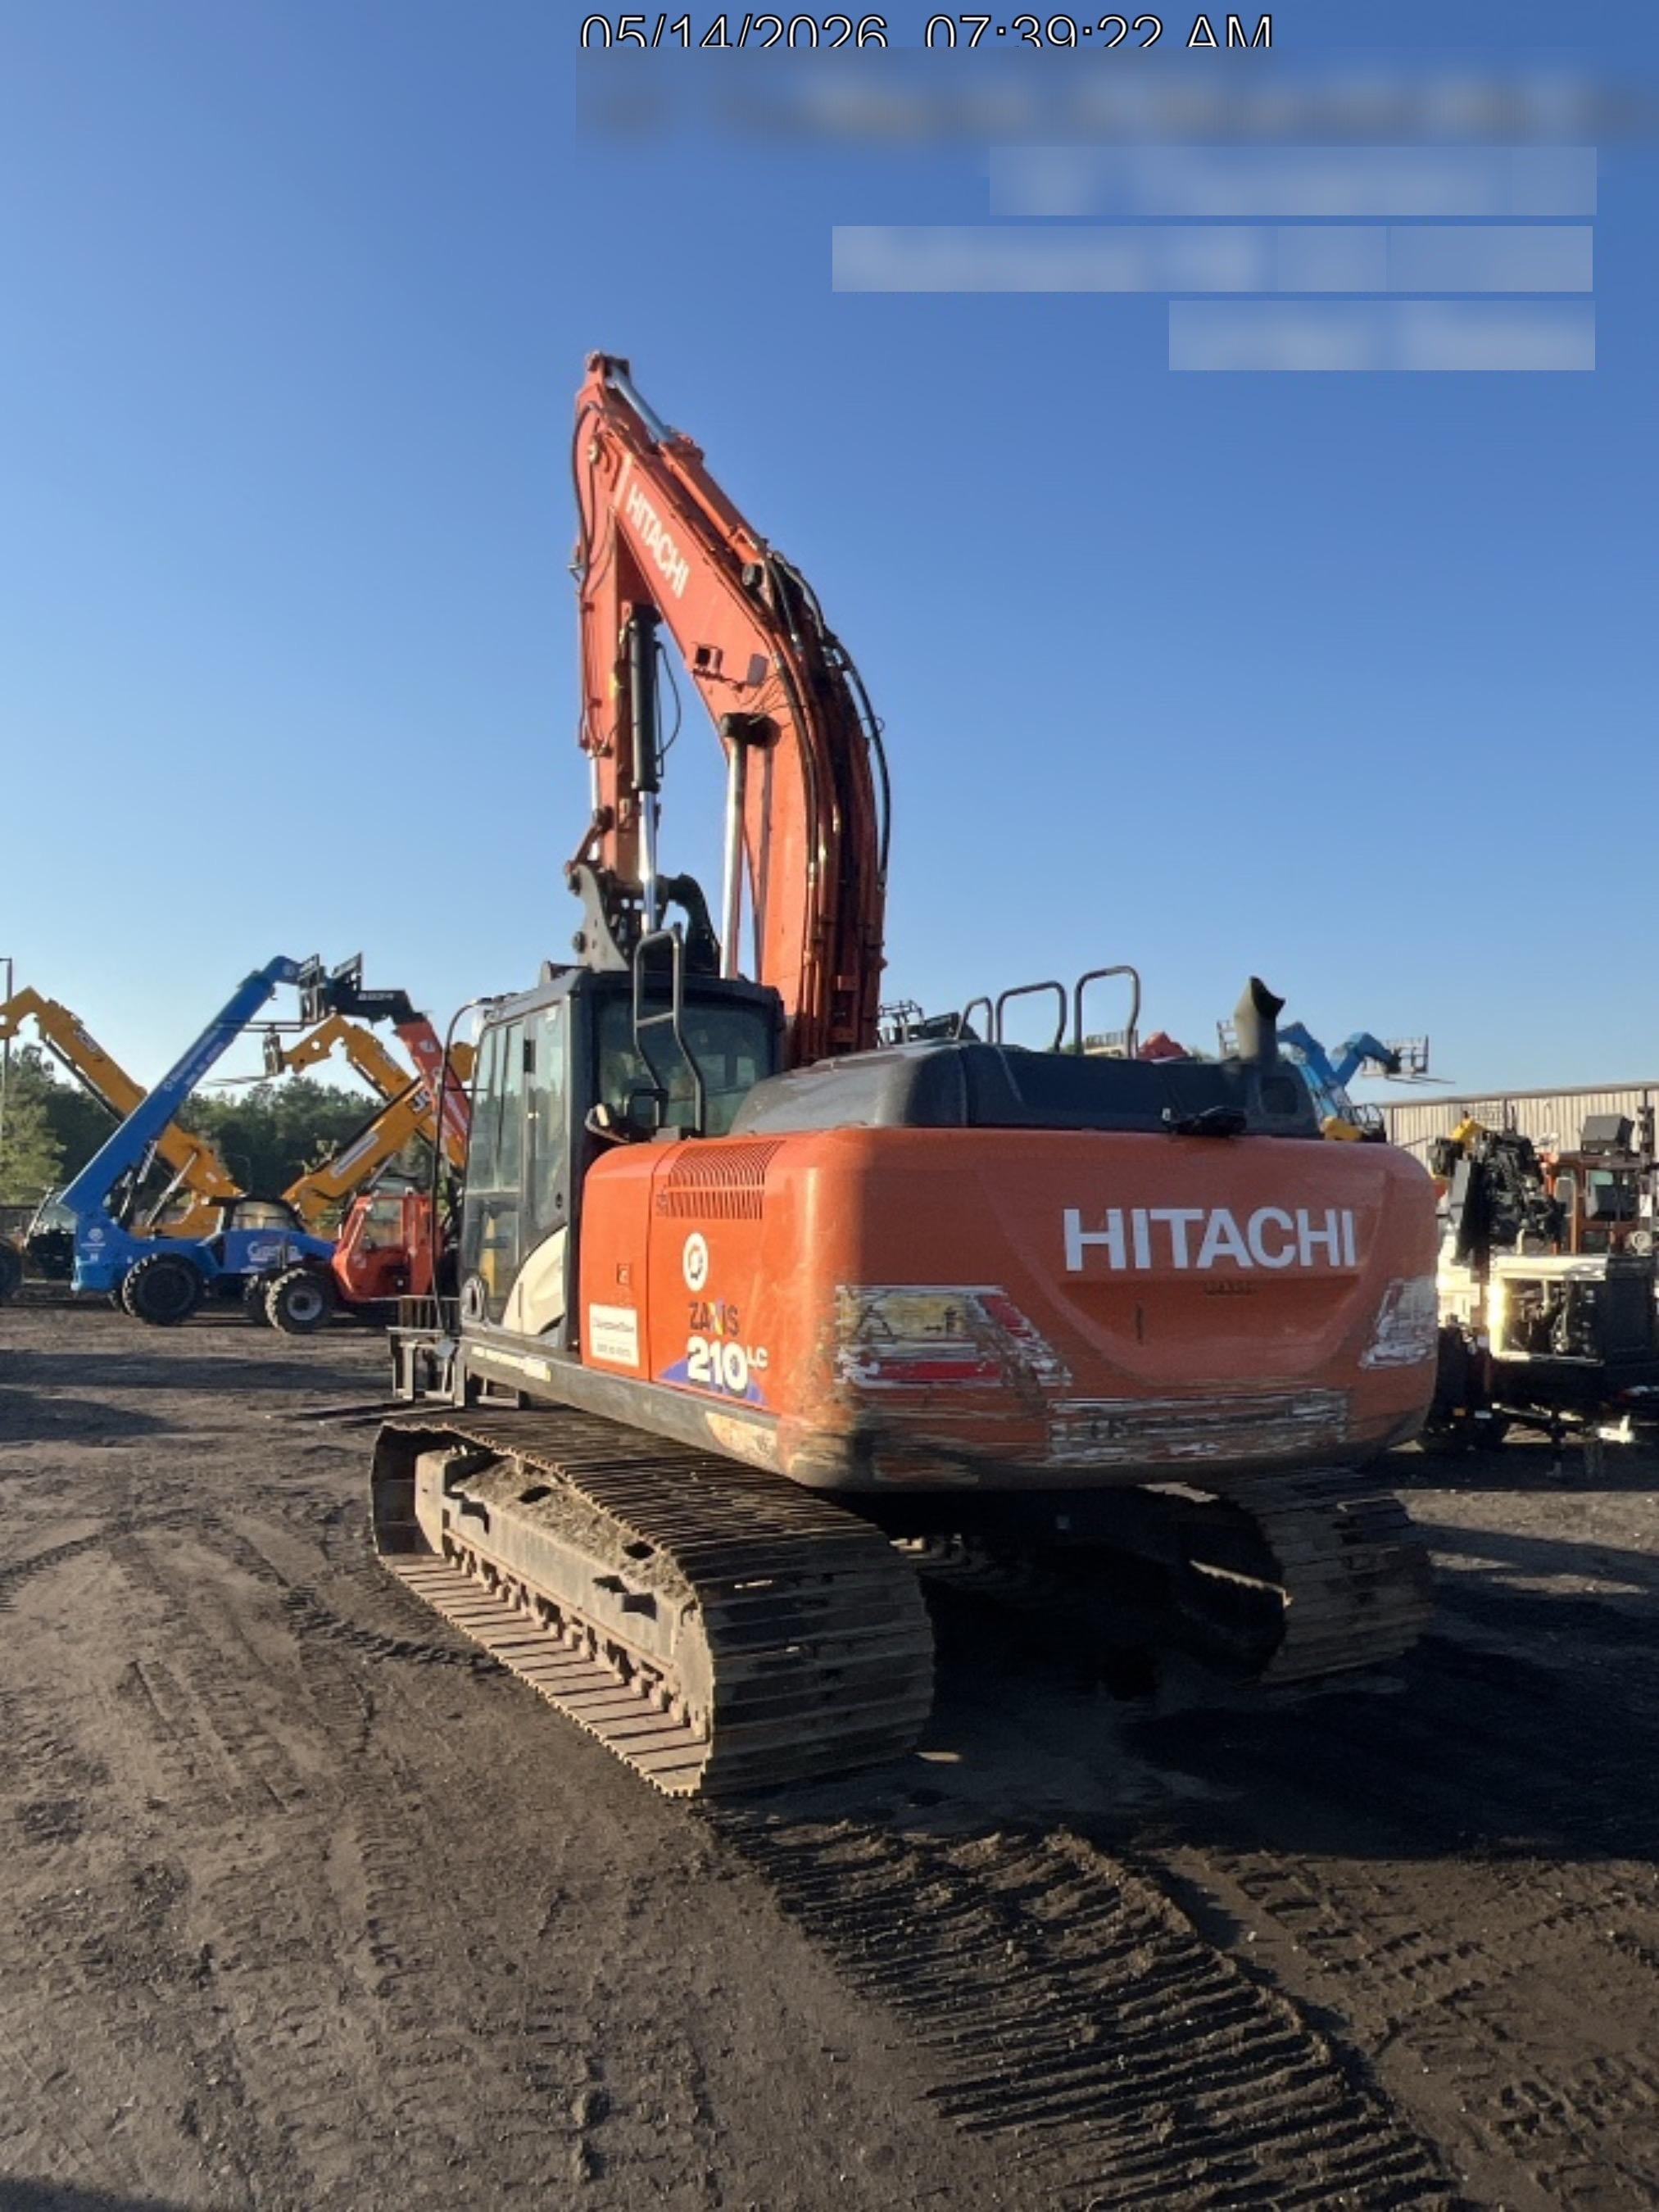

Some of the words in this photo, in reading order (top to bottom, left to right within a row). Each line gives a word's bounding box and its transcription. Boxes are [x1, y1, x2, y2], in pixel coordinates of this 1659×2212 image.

[626, 483, 689, 599] HITACHI
[1063, 1207, 1356, 1271] HITACHI
[687, 1336, 749, 1392] 210
[746, 1346, 768, 1368] LC
